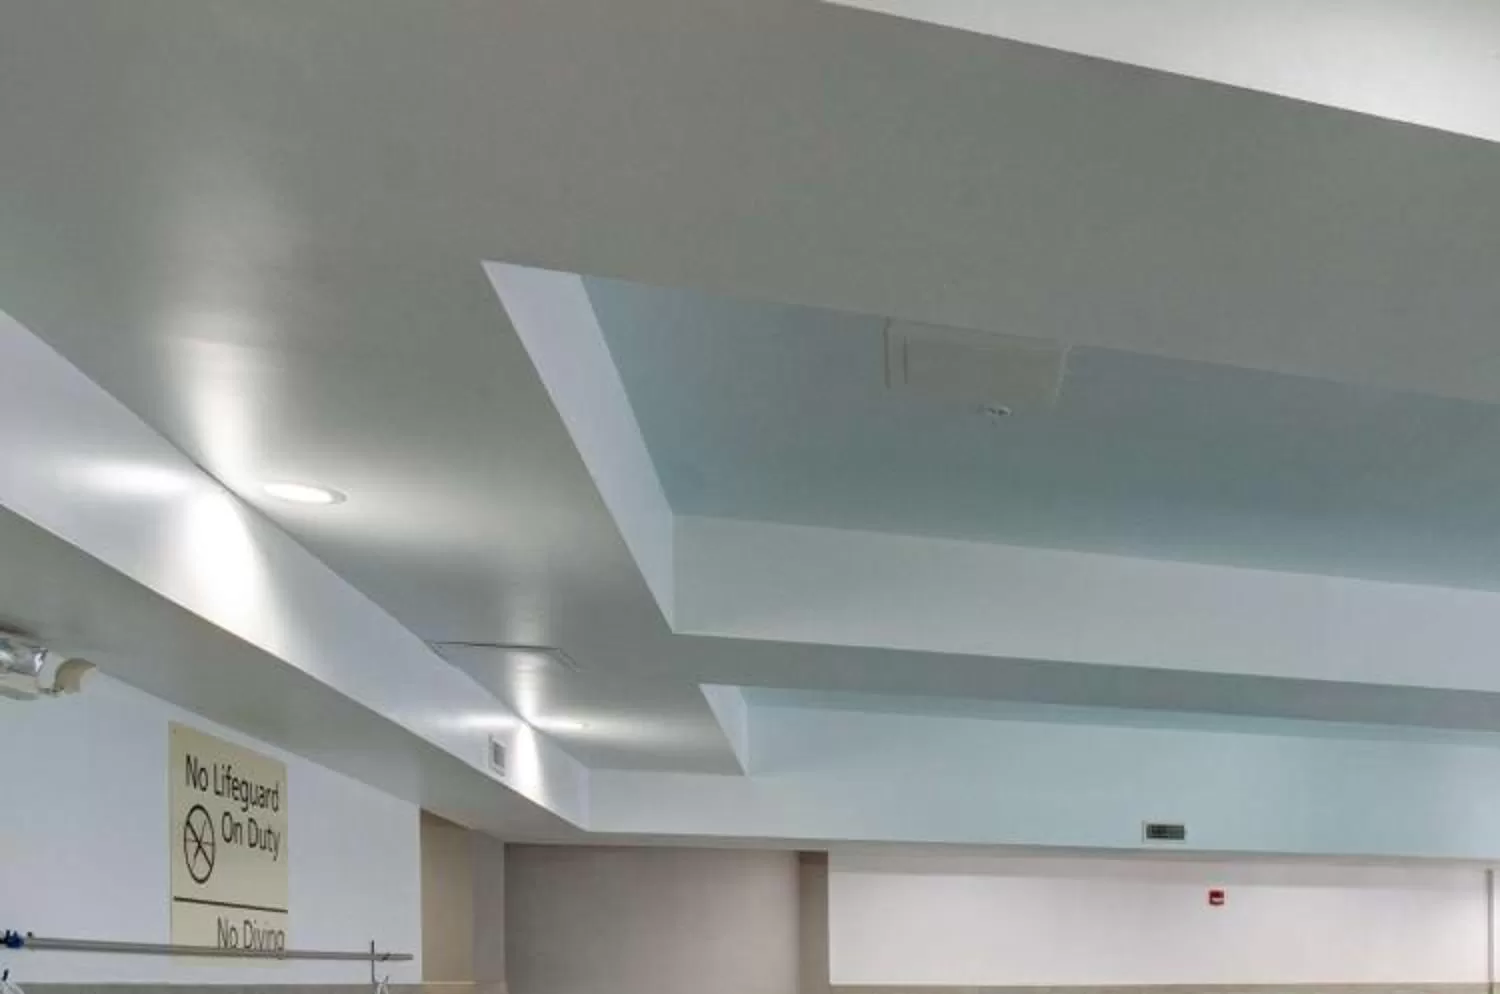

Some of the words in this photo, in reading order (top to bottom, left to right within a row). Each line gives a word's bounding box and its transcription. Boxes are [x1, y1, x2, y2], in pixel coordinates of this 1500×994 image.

[186, 755, 208, 792] No
[213, 764, 279, 813] Lifeguard
[221, 811, 243, 846] On
[248, 817, 281, 861] Duty
[217, 916, 238, 950] No
[243, 919, 285, 959] Diving
